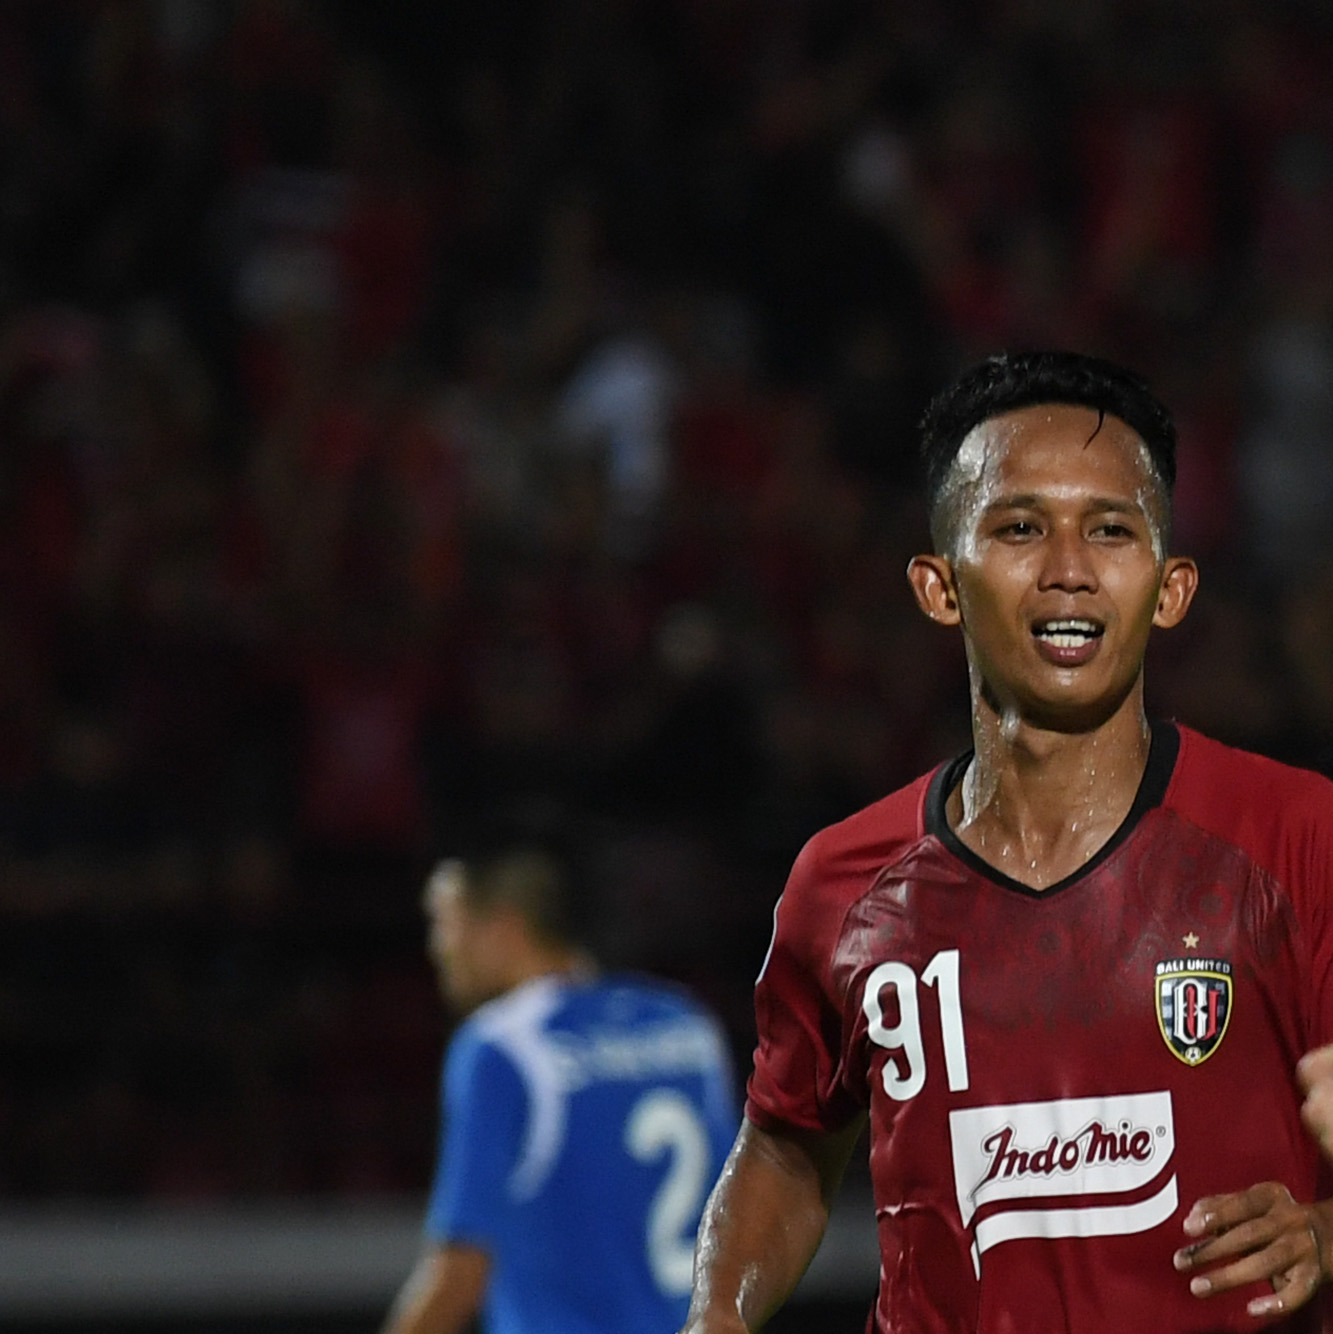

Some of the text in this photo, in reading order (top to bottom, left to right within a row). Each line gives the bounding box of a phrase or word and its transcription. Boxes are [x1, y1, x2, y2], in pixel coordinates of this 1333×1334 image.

[862, 948, 969, 1101] 91
[1156, 959, 1231, 975] BALI UNITED
[624, 1087, 707, 1298] 2
